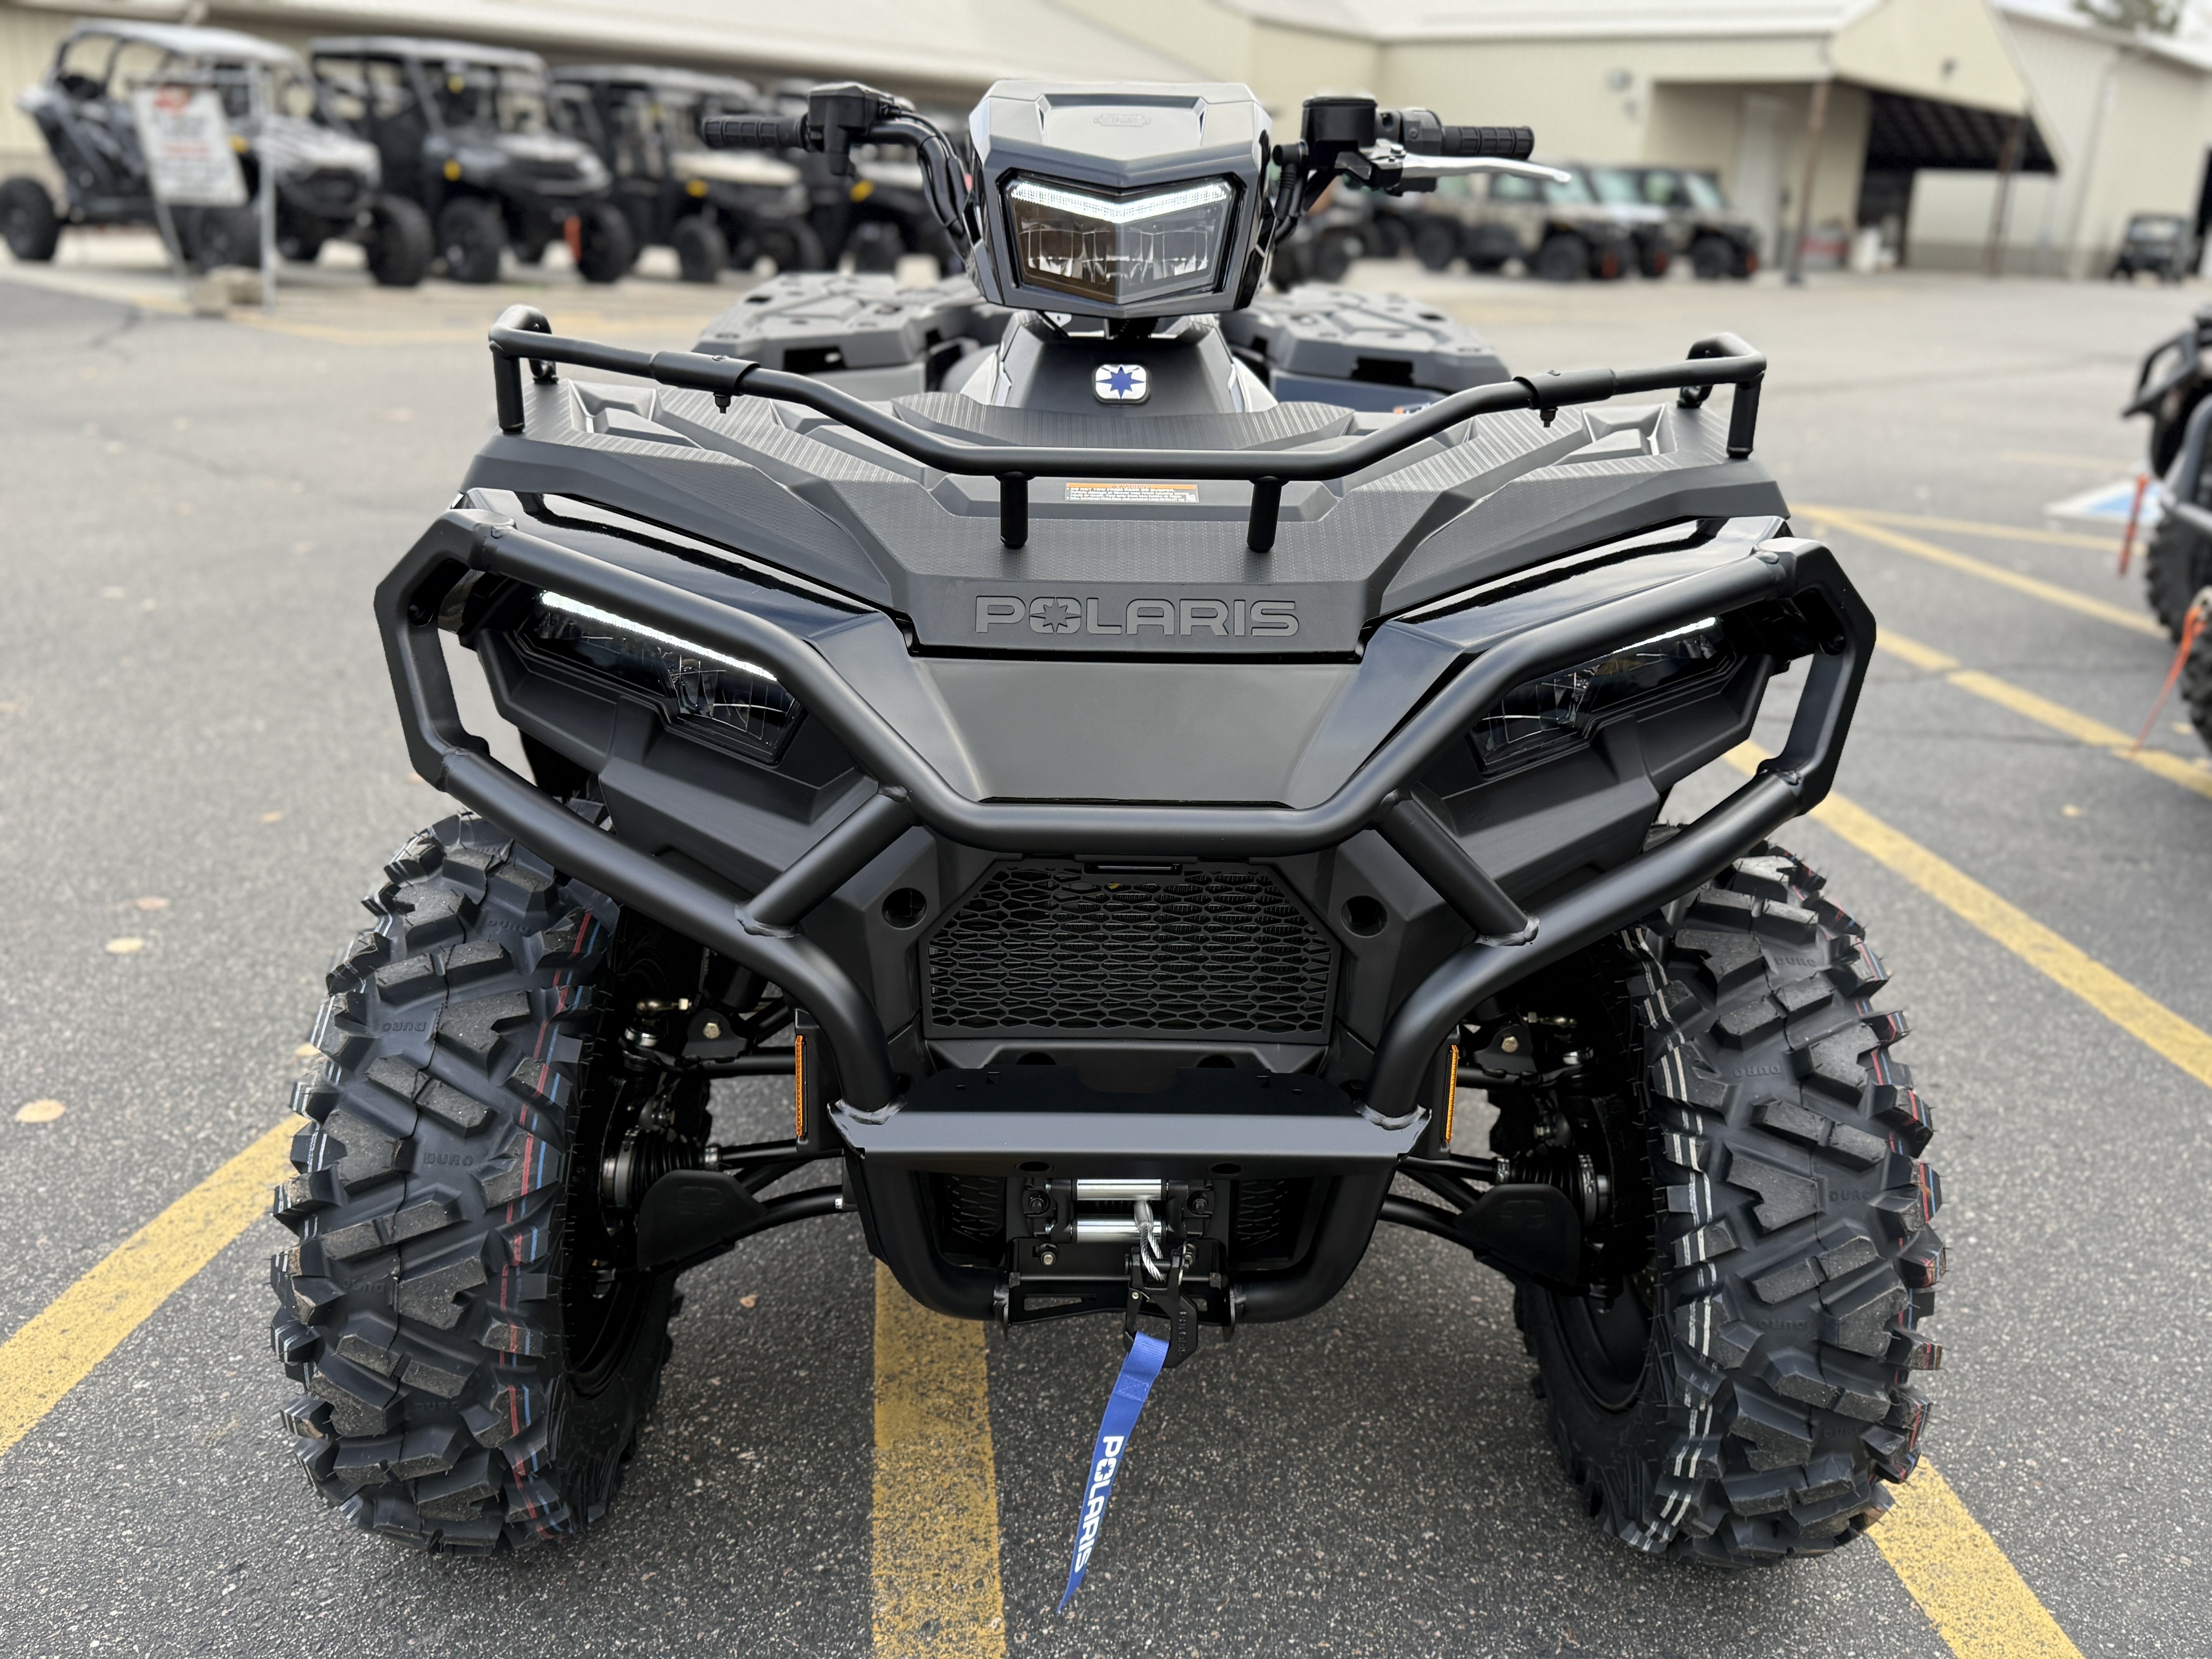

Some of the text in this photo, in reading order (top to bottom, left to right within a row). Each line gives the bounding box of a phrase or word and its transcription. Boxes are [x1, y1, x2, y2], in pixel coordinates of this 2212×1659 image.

[975, 595, 1300, 637] POLARIS
[382, 1021, 426, 1032] DURO
[1732, 1065, 1781, 1078] DURO
[424, 1153, 474, 1166] DURO
[342, 1278, 386, 1293] DUO
[1074, 1435, 1125, 1573] POLARIS
